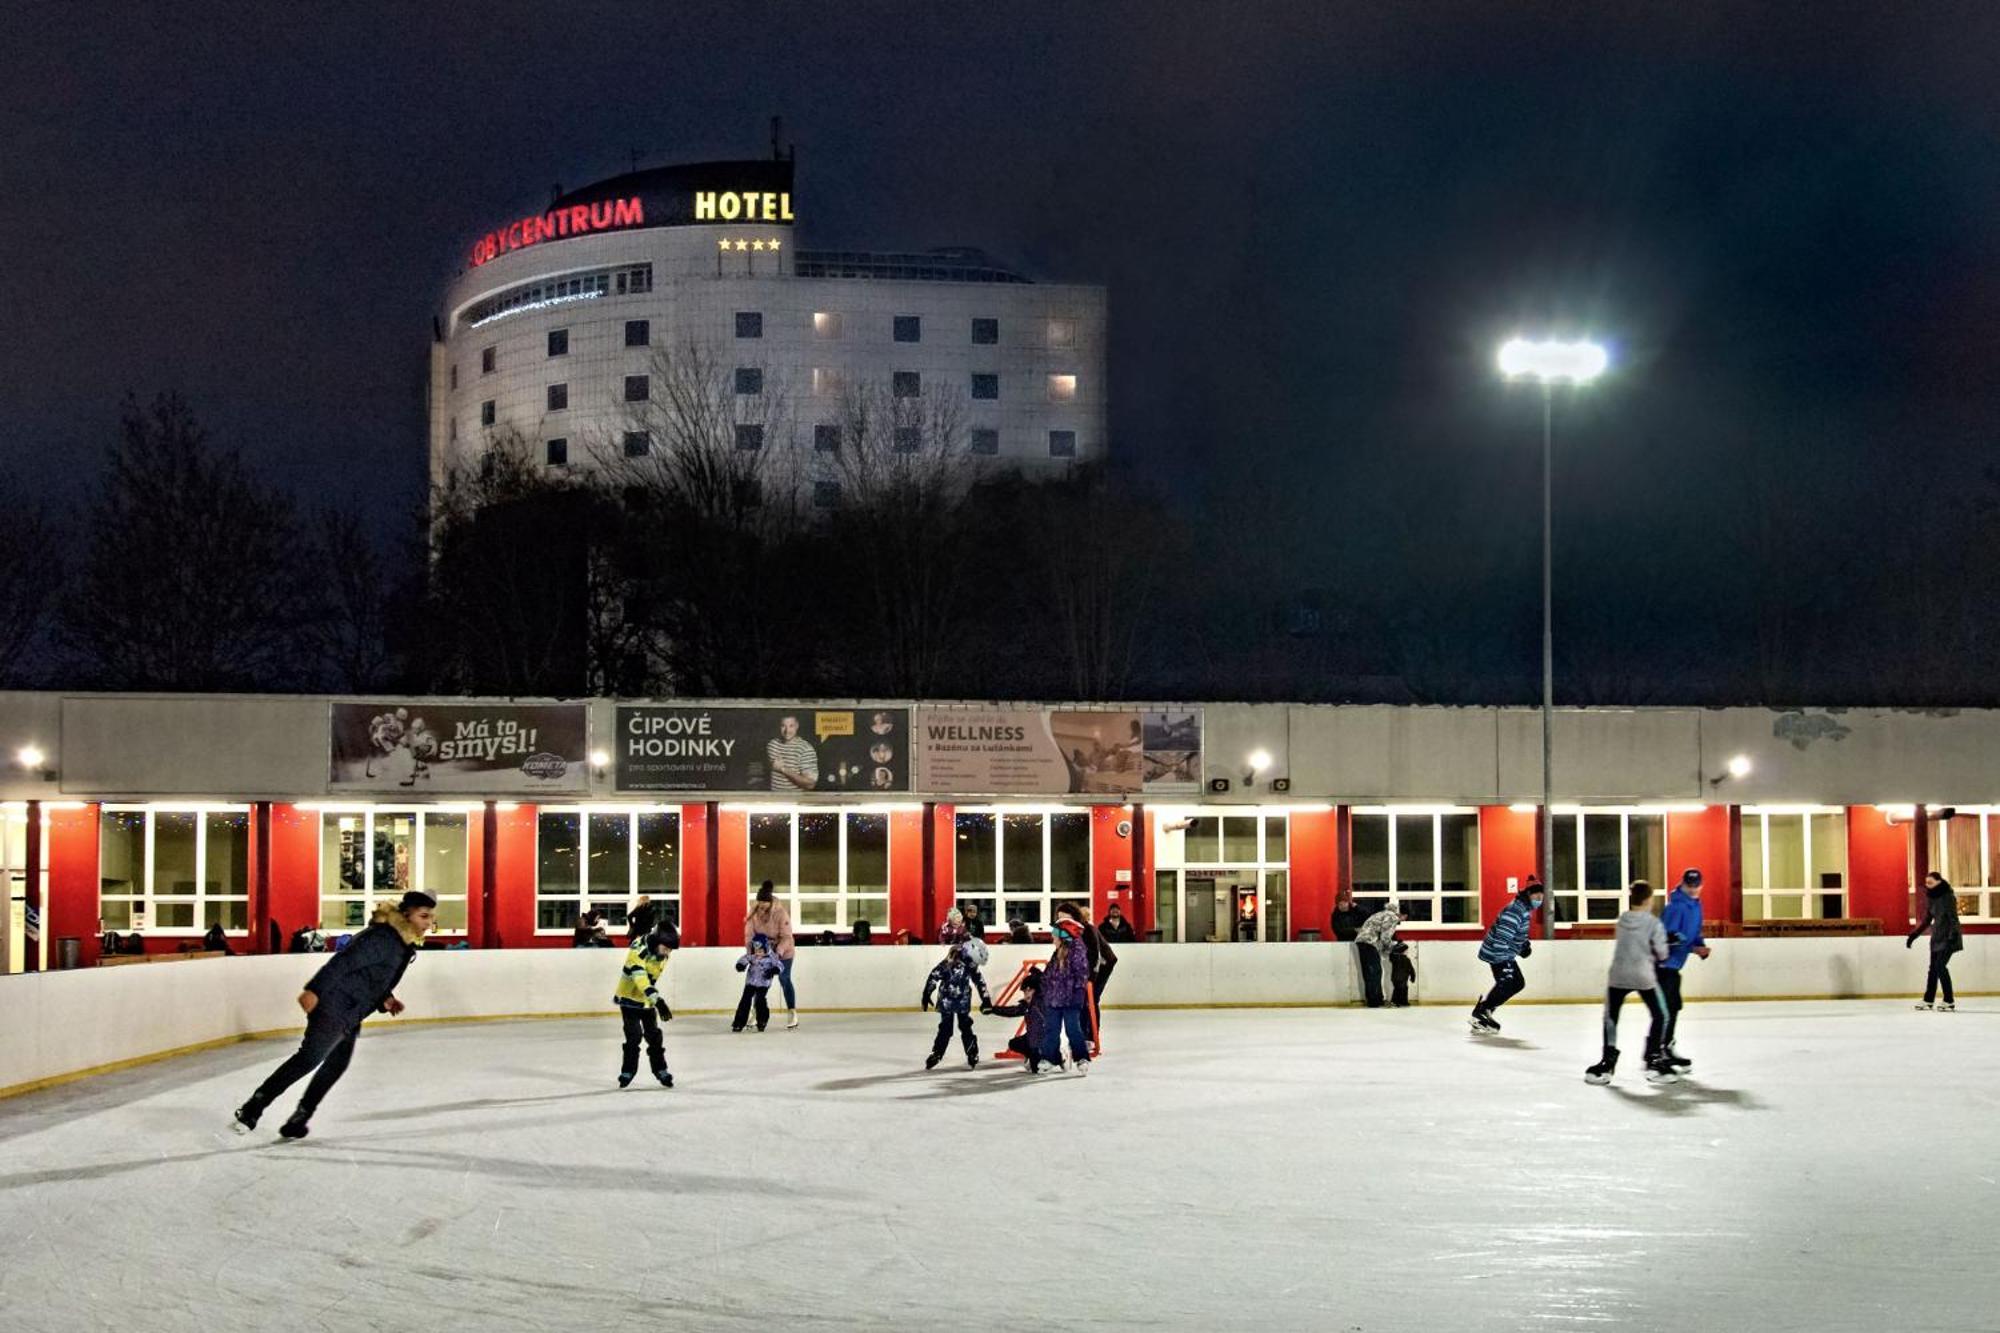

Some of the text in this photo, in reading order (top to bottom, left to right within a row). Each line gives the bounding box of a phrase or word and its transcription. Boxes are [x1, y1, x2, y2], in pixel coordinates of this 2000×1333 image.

[695, 192, 794, 220] HOTEL
[469, 196, 644, 267] OBYCENTRUM
[455, 719, 518, 740] Má to
[629, 712, 712, 735] ČIPOVÉ
[927, 726, 1025, 741] WELLNESS
[439, 728, 538, 761] smysl!
[629, 739, 736, 757] HODINKY
[628, 764, 644, 773] pro
